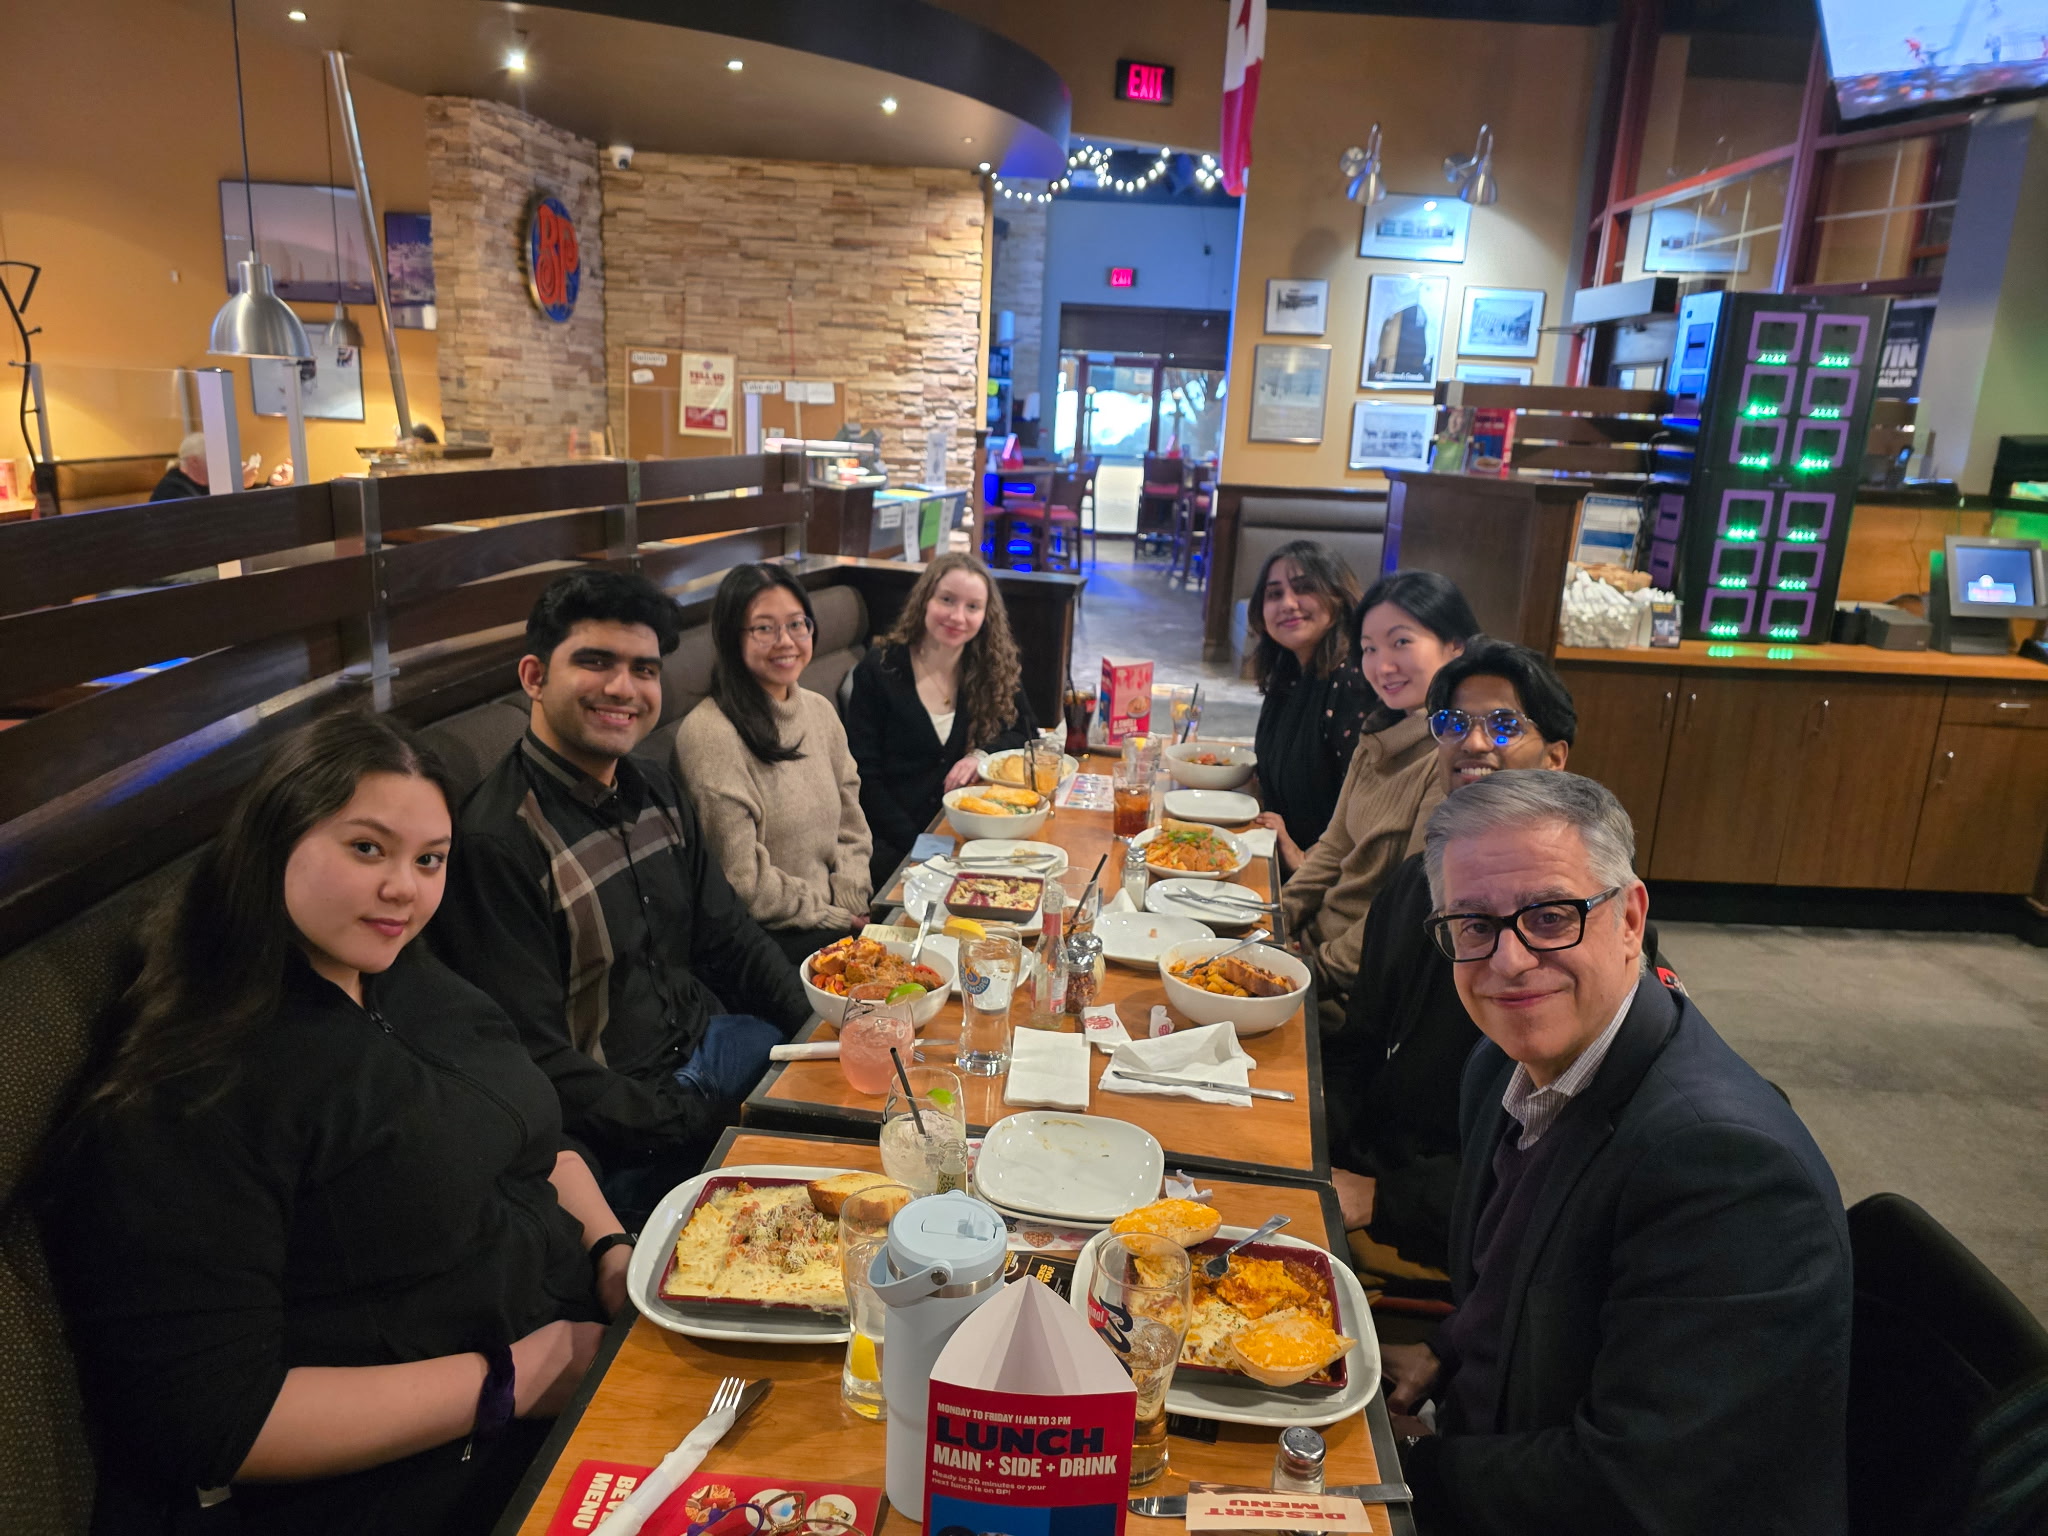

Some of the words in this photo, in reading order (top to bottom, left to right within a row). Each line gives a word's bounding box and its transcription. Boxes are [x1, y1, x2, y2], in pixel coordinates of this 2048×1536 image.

[1127, 64, 1165, 101] EXIT
[535, 204, 579, 304] BP
[689, 370, 711, 381] TELL
[1042, 1266, 1055, 1282] YOU!
[937, 1402, 971, 1417] MONDAY
[972, 1409, 983, 1420] TO
[984, 1411, 1013, 1423] FRIDAY
[1015, 1415, 1022, 1424] 11
[1024, 1415, 1037, 1425] AM
[1039, 1416, 1049, 1425] TO
[1050, 1416, 1056, 1425] 3
[1057, 1416, 1071, 1425] PM
[936, 1415, 1104, 1456] LUNCH
[933, 1444, 981, 1472] MAIN
[999, 1455, 1042, 1478] SIDE
[1060, 1455, 1118, 1478] DRINK
[932, 1469, 958, 1482] Ready
[959, 1474, 966, 1483] in
[968, 1477, 980, 1485] 20
[981, 1480, 1015, 1490] minutes
[932, 1477, 949, 1487] next
[951, 1481, 973, 1491] lunch
[996, 1488, 1011, 1496] BP!
[572, 1472, 614, 1529] MENU
[1229, 1500, 1319, 1510] MENU
[1205, 1508, 1347, 1520] DESSERT
